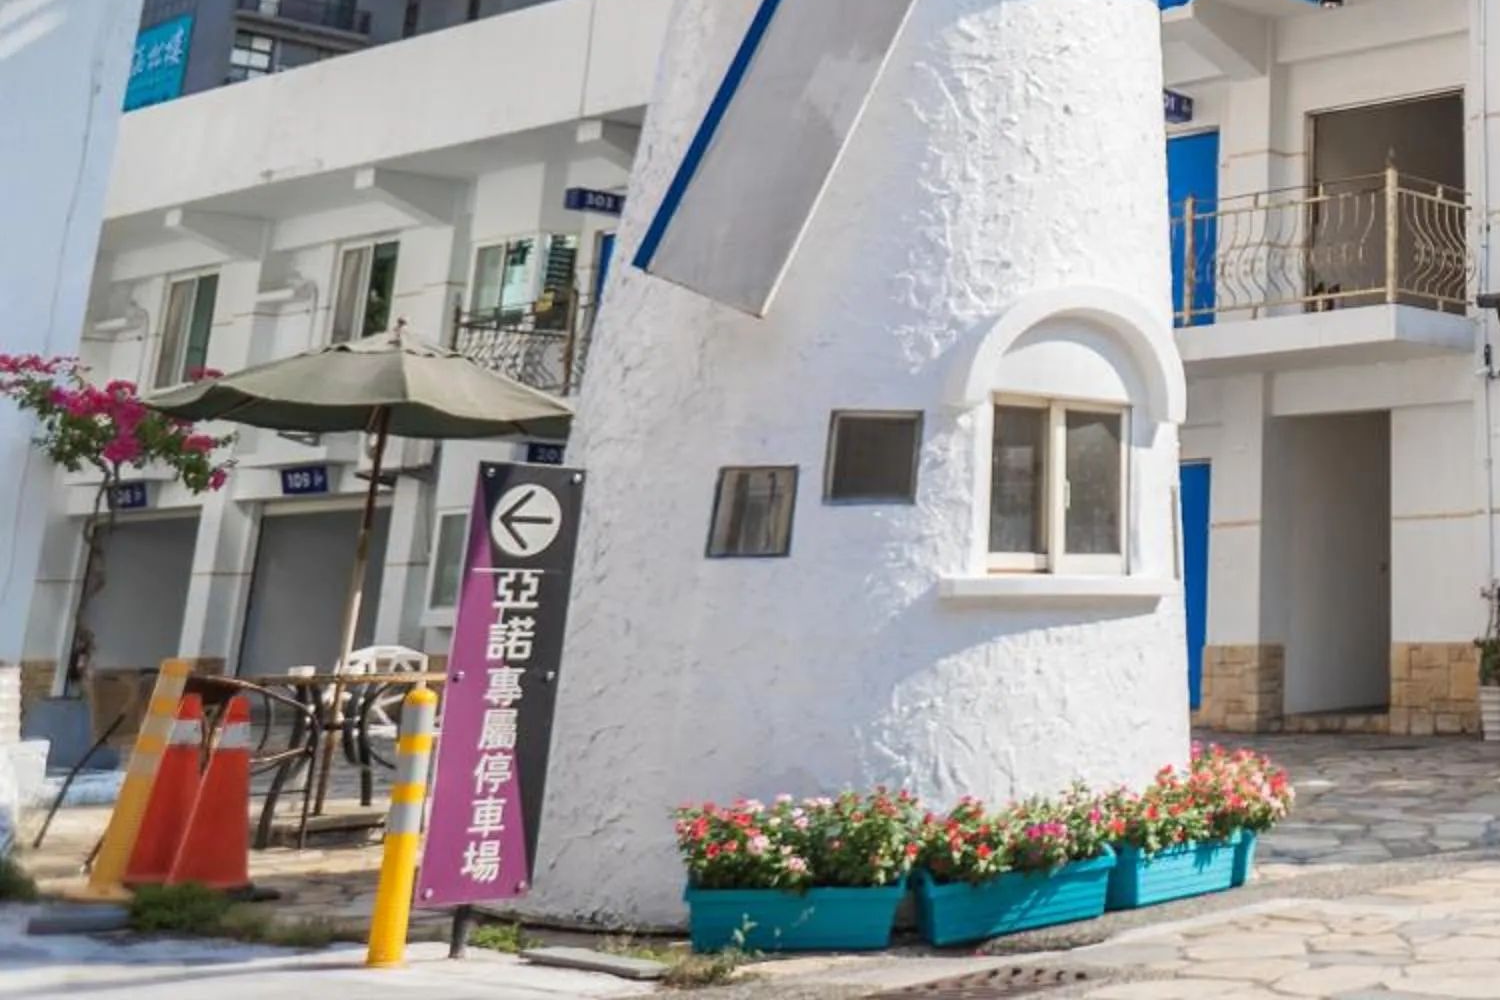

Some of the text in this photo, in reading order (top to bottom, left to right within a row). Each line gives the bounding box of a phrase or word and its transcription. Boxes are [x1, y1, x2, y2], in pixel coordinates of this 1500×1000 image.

[461, 569, 540, 883] 亞諾專屬停車場
